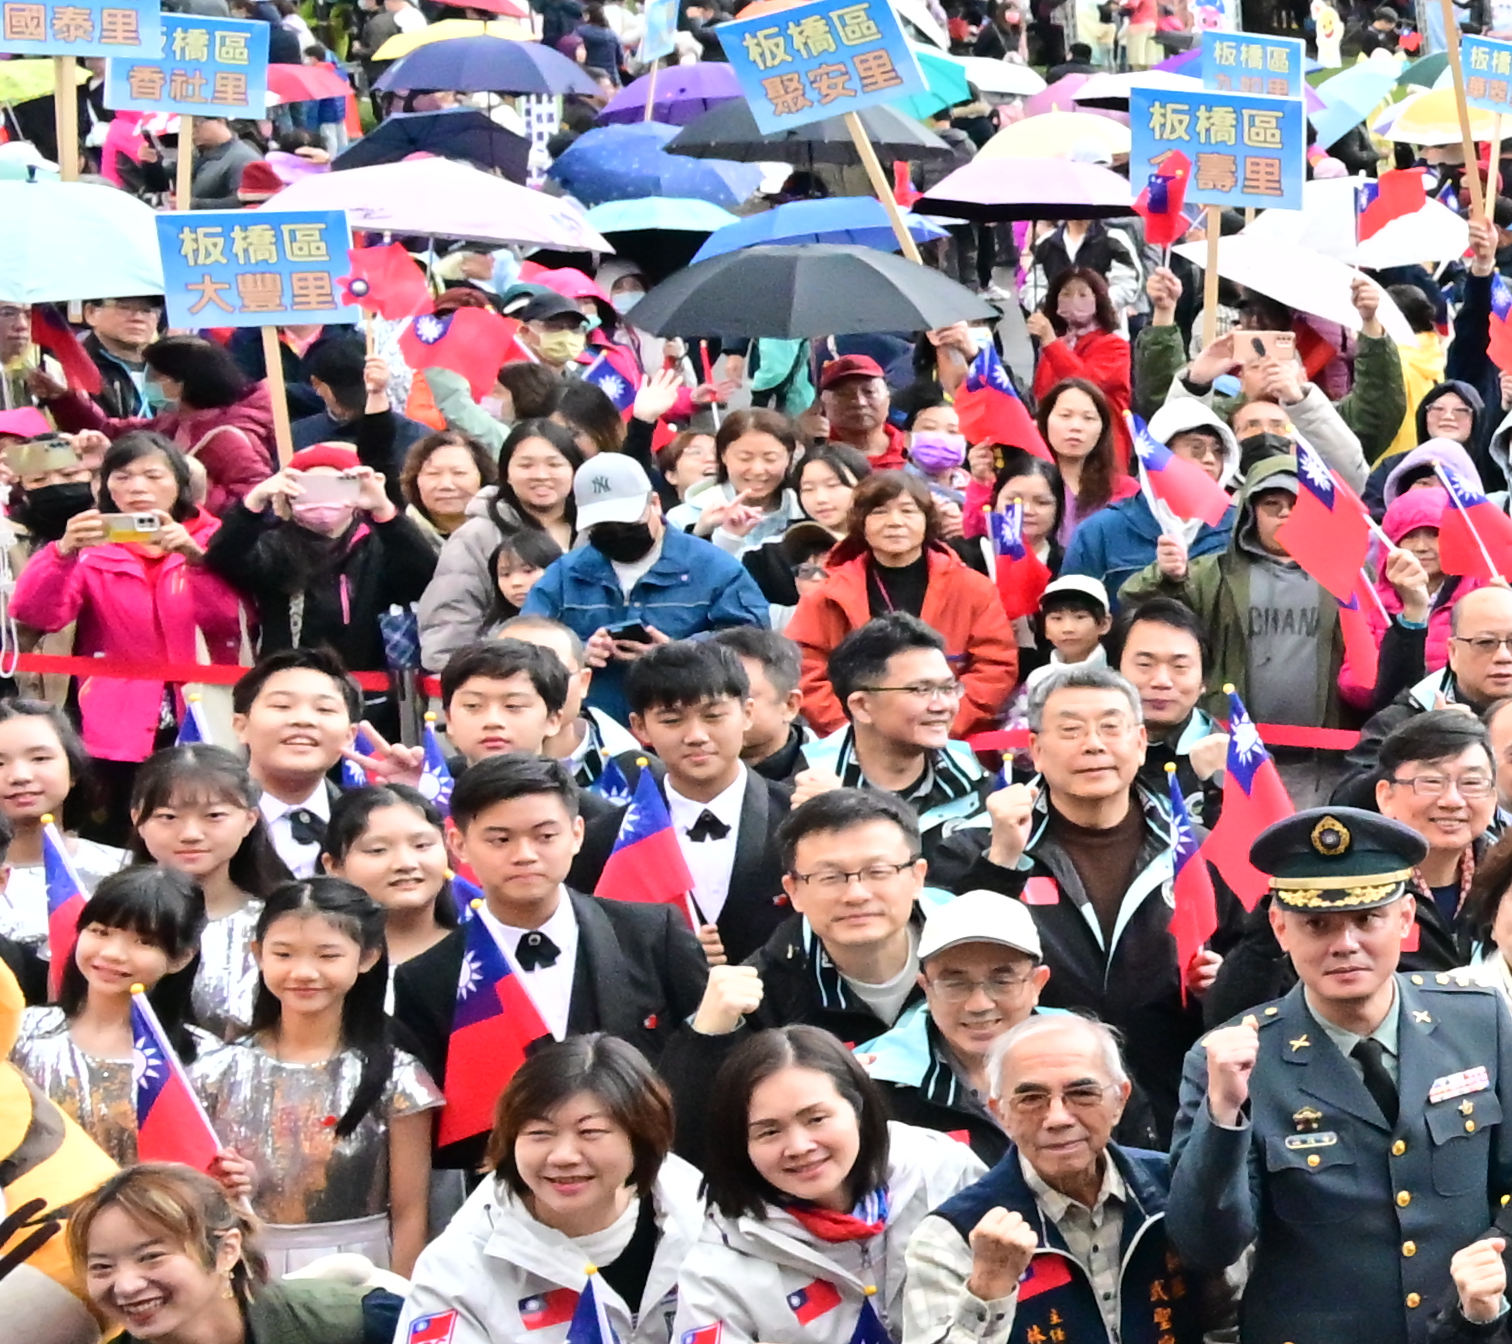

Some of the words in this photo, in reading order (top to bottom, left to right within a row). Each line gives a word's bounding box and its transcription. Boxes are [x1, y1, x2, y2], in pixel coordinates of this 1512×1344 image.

[3, 2, 142, 46] 國泰里
[160, 26, 251, 65] 橋區
[742, 2, 883, 70] 板橋區
[1214, 40, 1290, 73] 板橋區
[128, 64, 250, 106] 香社里
[1149, 100, 1284, 149] 板橋區
[179, 223, 331, 268] 板橋區
[186, 271, 339, 316] 大豐里
